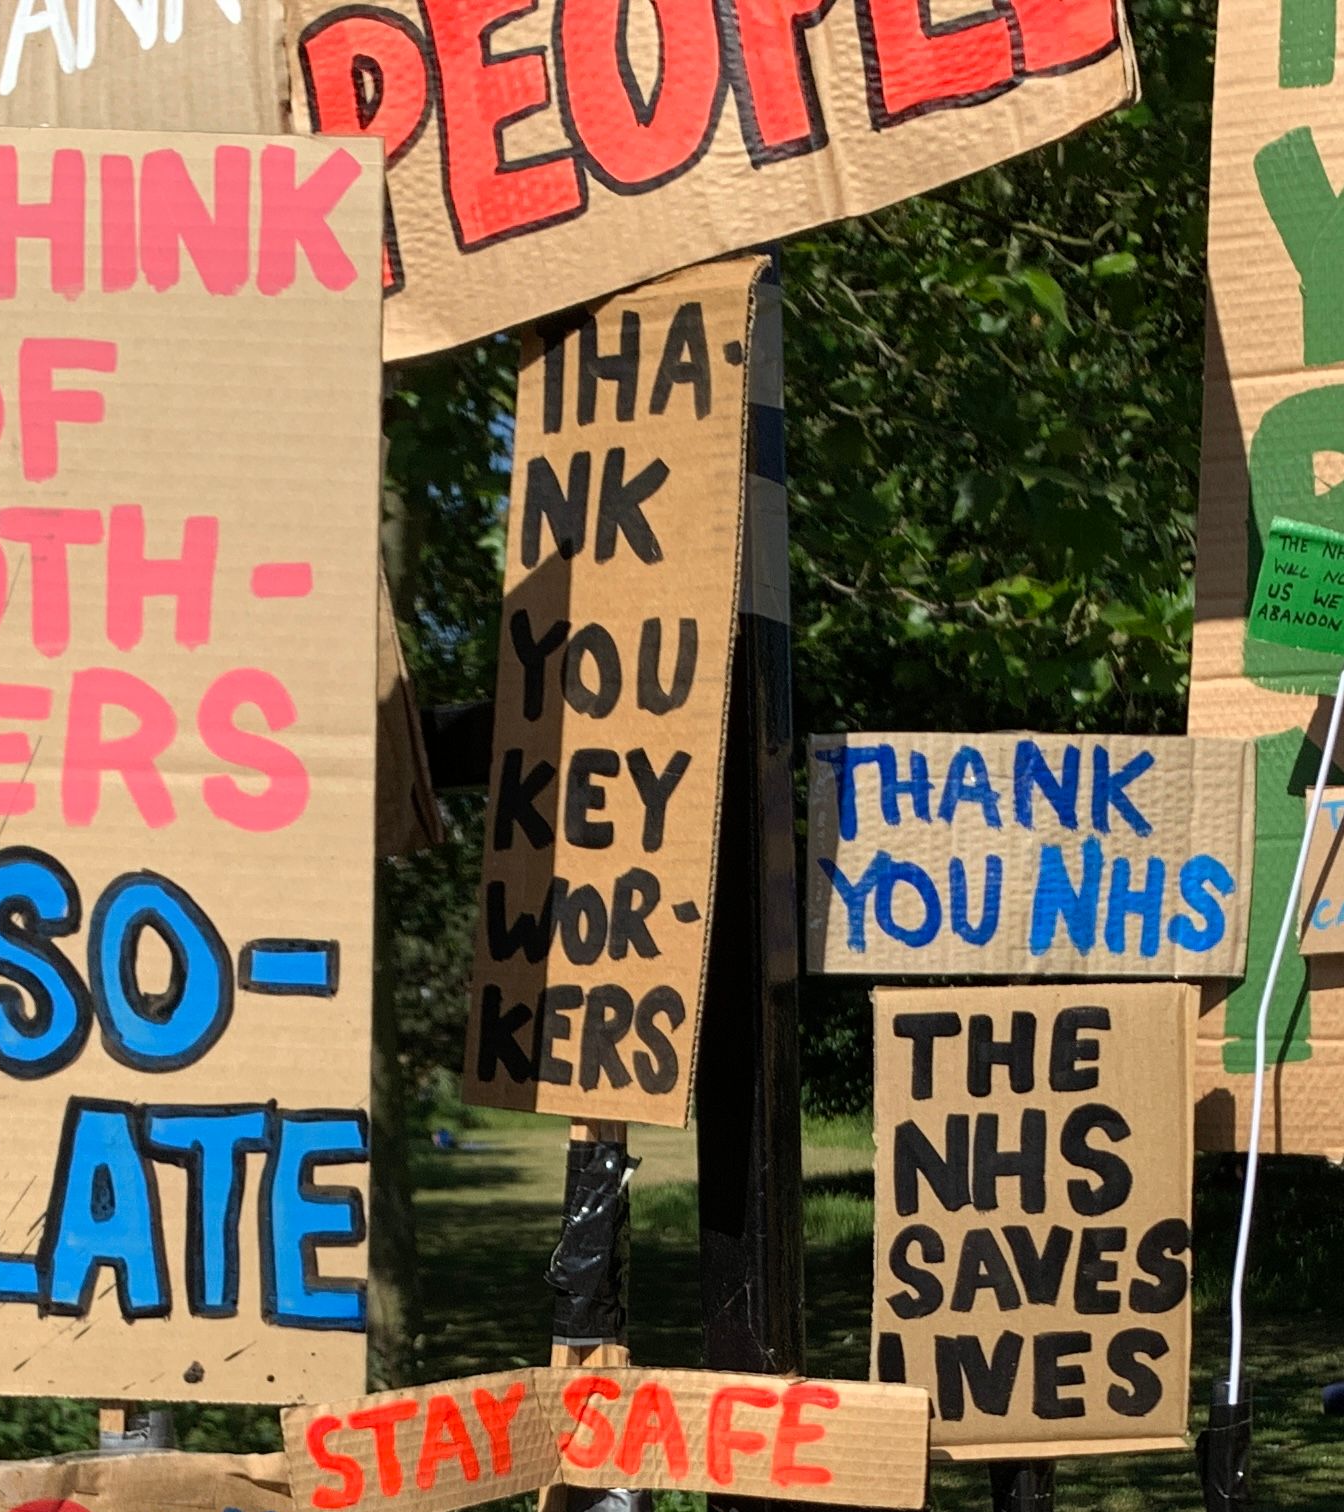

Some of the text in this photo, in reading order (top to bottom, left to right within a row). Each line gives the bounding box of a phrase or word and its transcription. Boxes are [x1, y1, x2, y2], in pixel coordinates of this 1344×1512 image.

[521, 447, 670, 569] NK
[1278, 534, 1309, 554] THE
[1257, 602, 1342, 633] ABANDON
[1267, 583, 1292, 602] US
[1312, 588, 1344, 610] WE
[1273, 557, 1310, 580] WILL
[508, 608, 699, 724] YOU
[492, 746, 692, 854] KEY
[815, 740, 1157, 841] THANK
[817, 834, 1236, 958] YOU NHS
[476, 983, 687, 1096] KERS
[892, 1005, 1112, 1101] THE
[892, 1102, 1134, 1218] NHS
[885, 1217, 1193, 1321] SAVES
[306, 1376, 841, 1511] STAY SAFE
